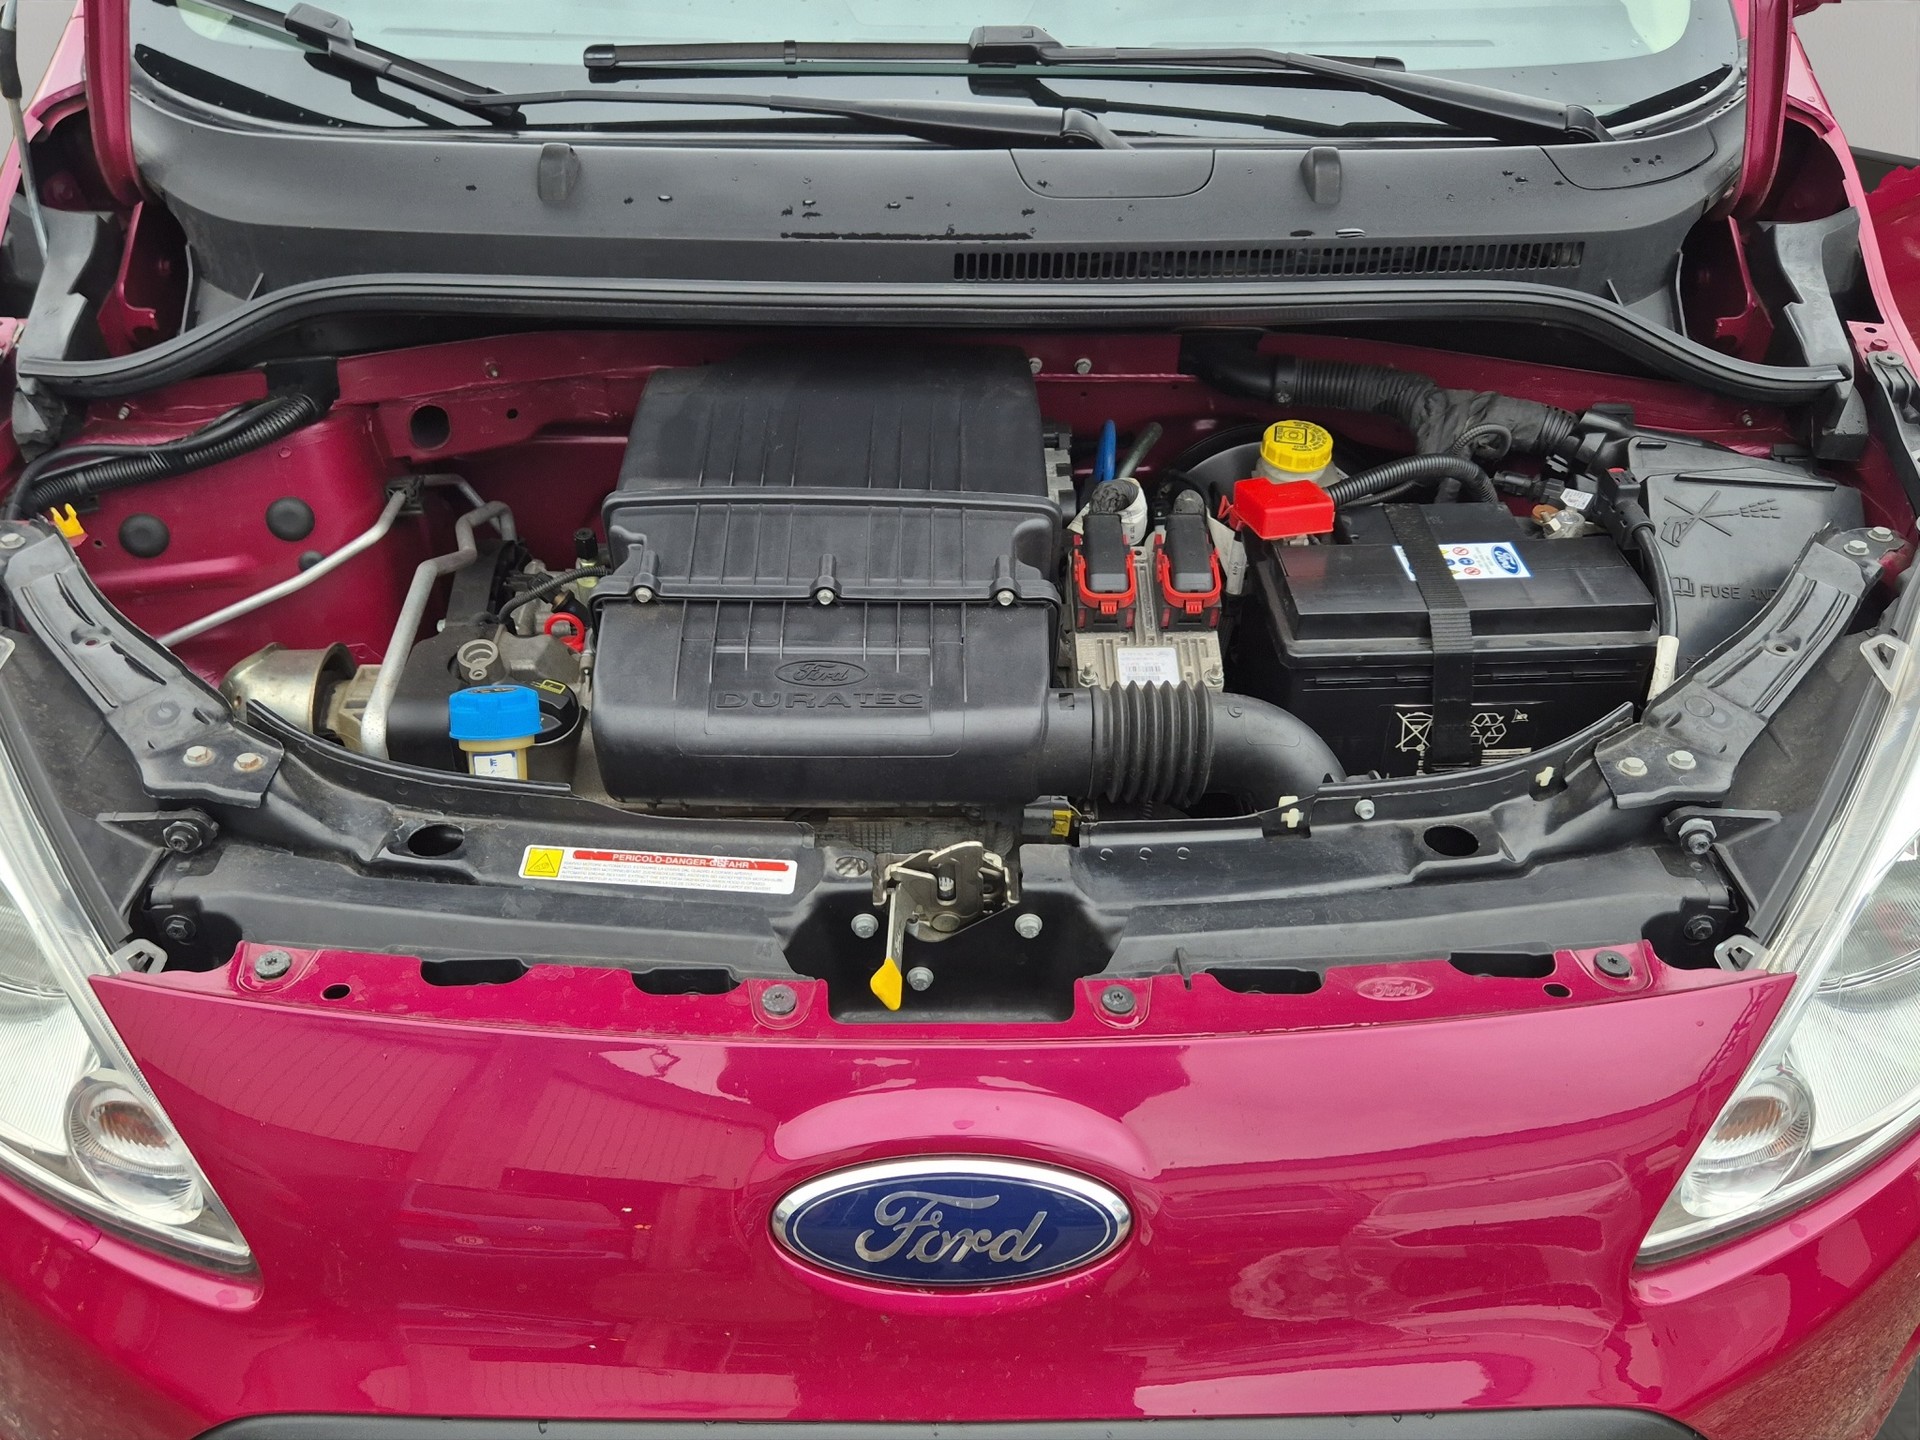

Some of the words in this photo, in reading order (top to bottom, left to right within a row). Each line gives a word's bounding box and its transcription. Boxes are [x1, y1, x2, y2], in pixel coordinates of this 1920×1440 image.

[1494, 550, 1516, 570] Ford
[1700, 585, 1741, 599] FUSE
[793, 662, 852, 682] Ford
[715, 692, 924, 708] DURATEC
[1372, 980, 1418, 998] Ford
[854, 1190, 1048, 1263] Ford
